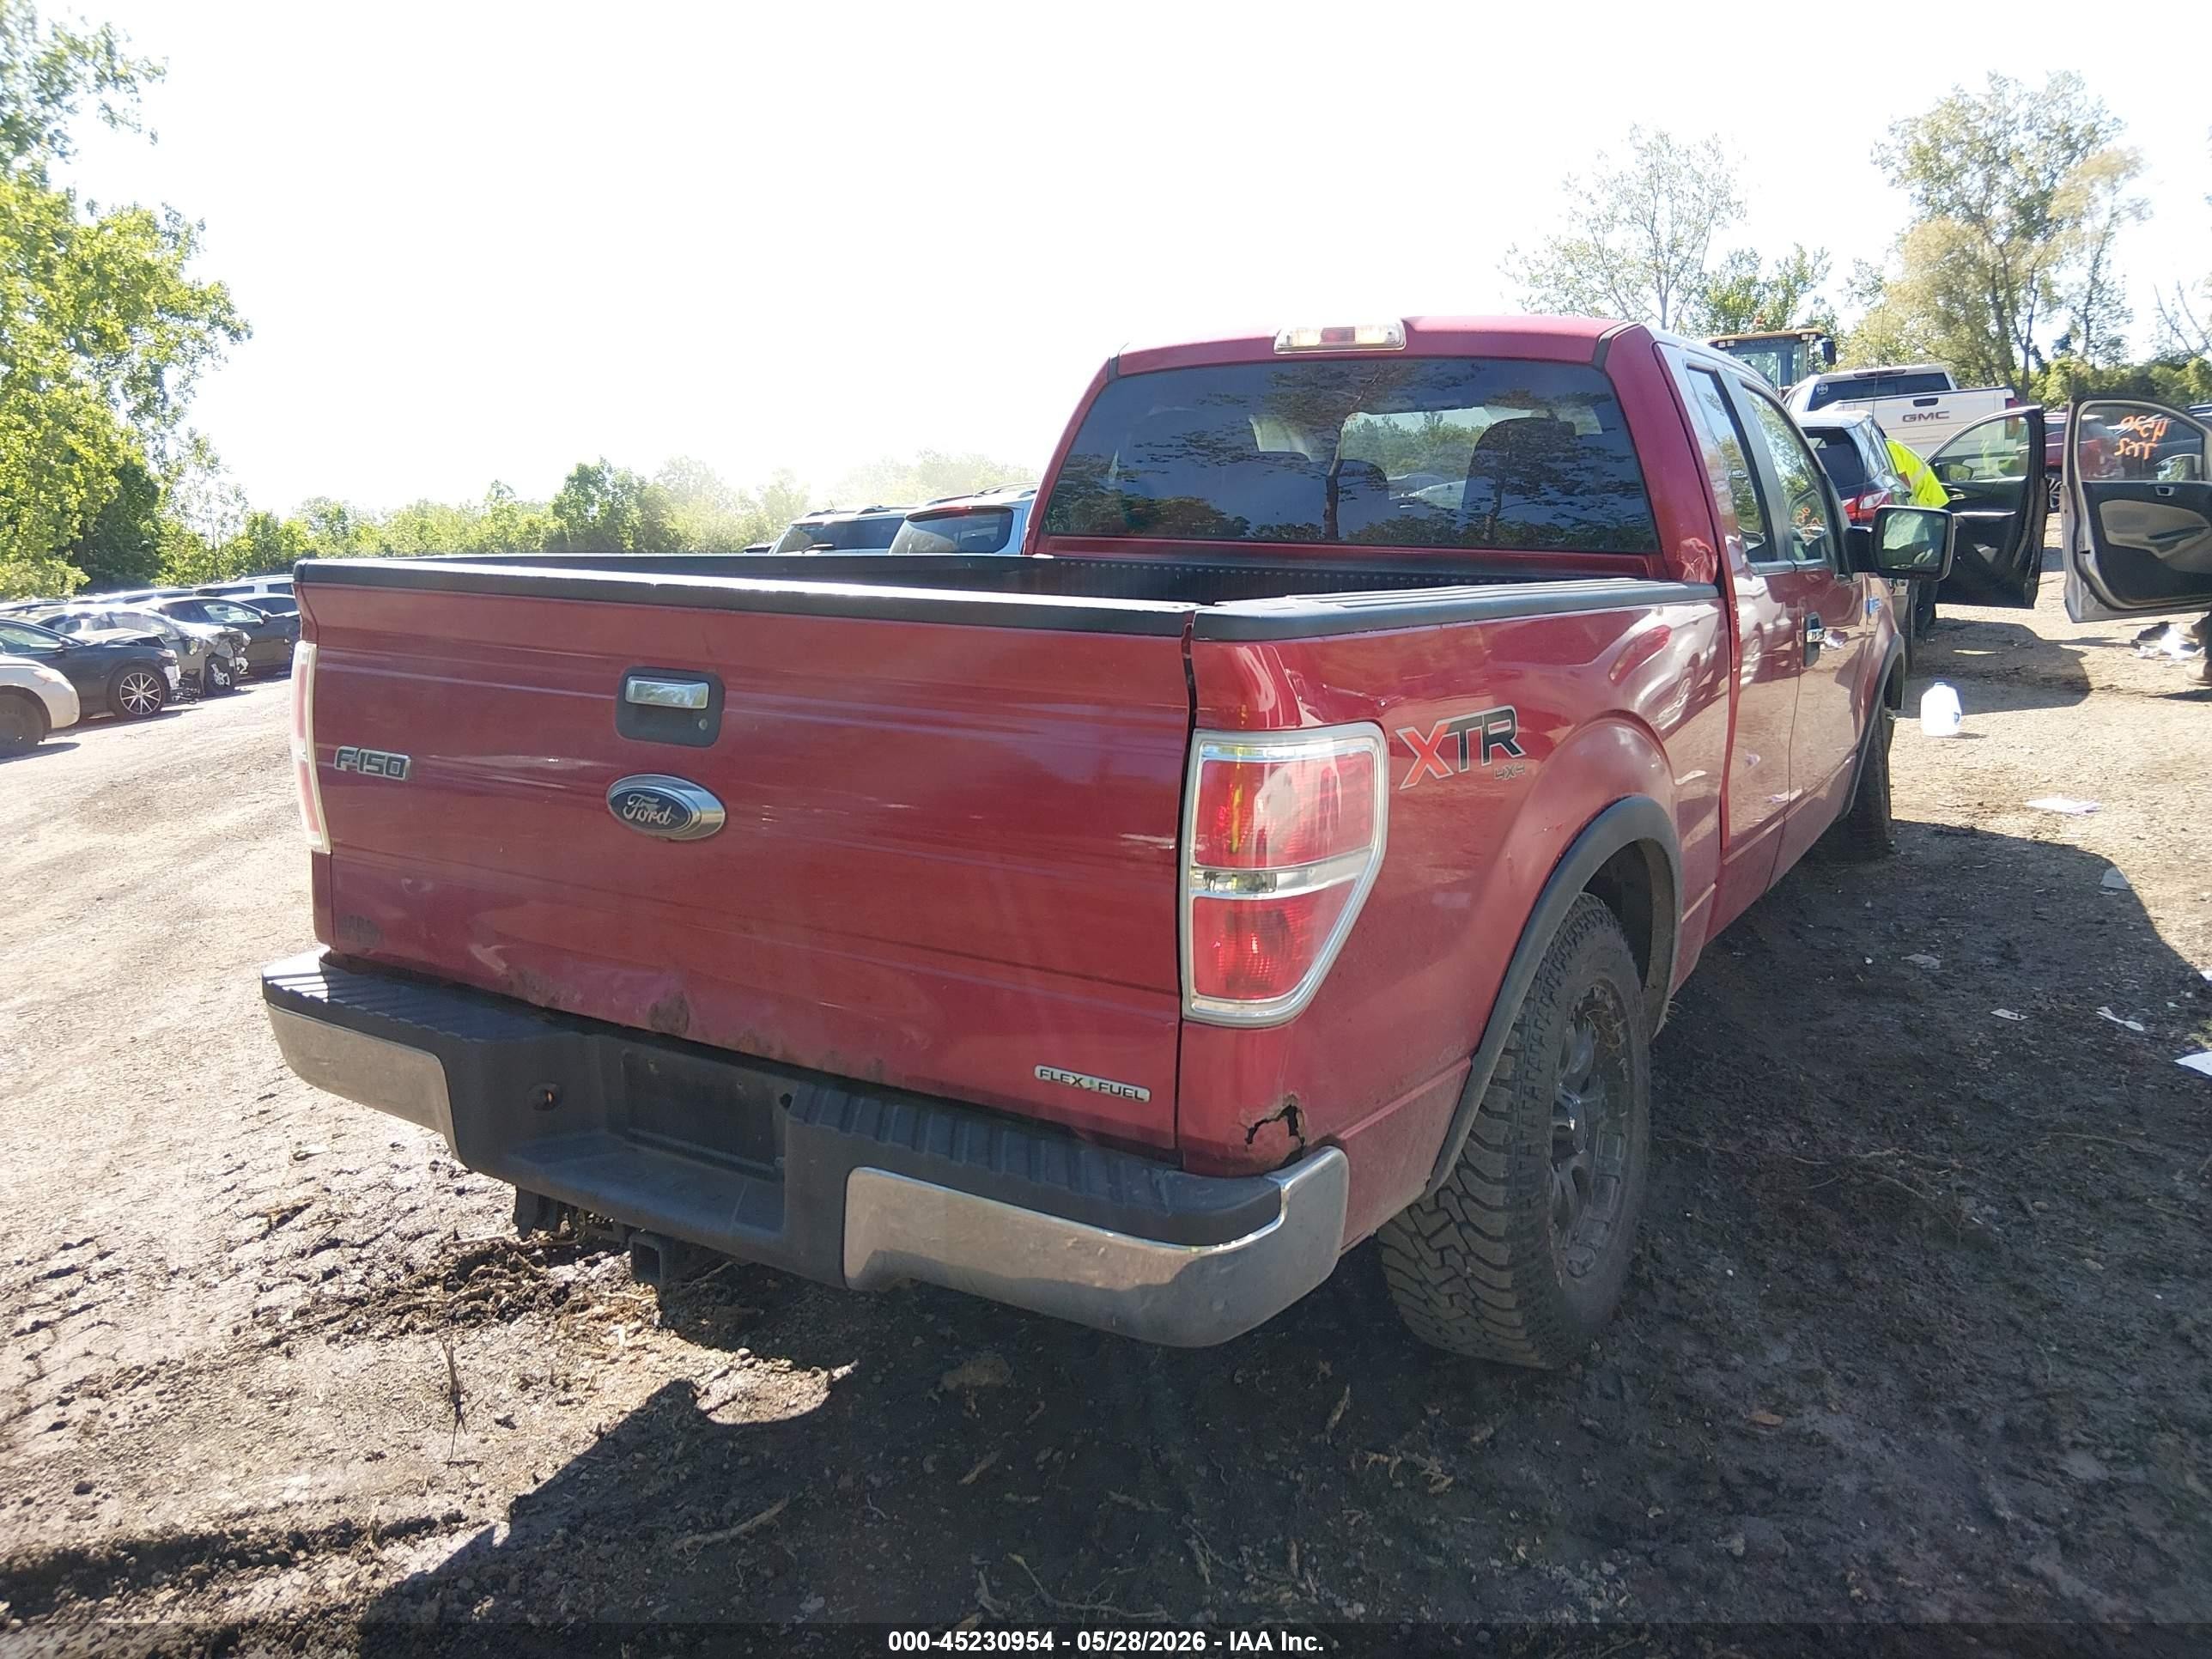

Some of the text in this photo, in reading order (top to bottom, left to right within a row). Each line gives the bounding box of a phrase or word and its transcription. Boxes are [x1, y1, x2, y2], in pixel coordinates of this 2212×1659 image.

[1901, 410, 1951, 422] GMC
[1395, 705, 1527, 790] XTR
[623, 793, 672, 825] Ford
[1039, 1068, 1146, 1101] FLEX FUEL
